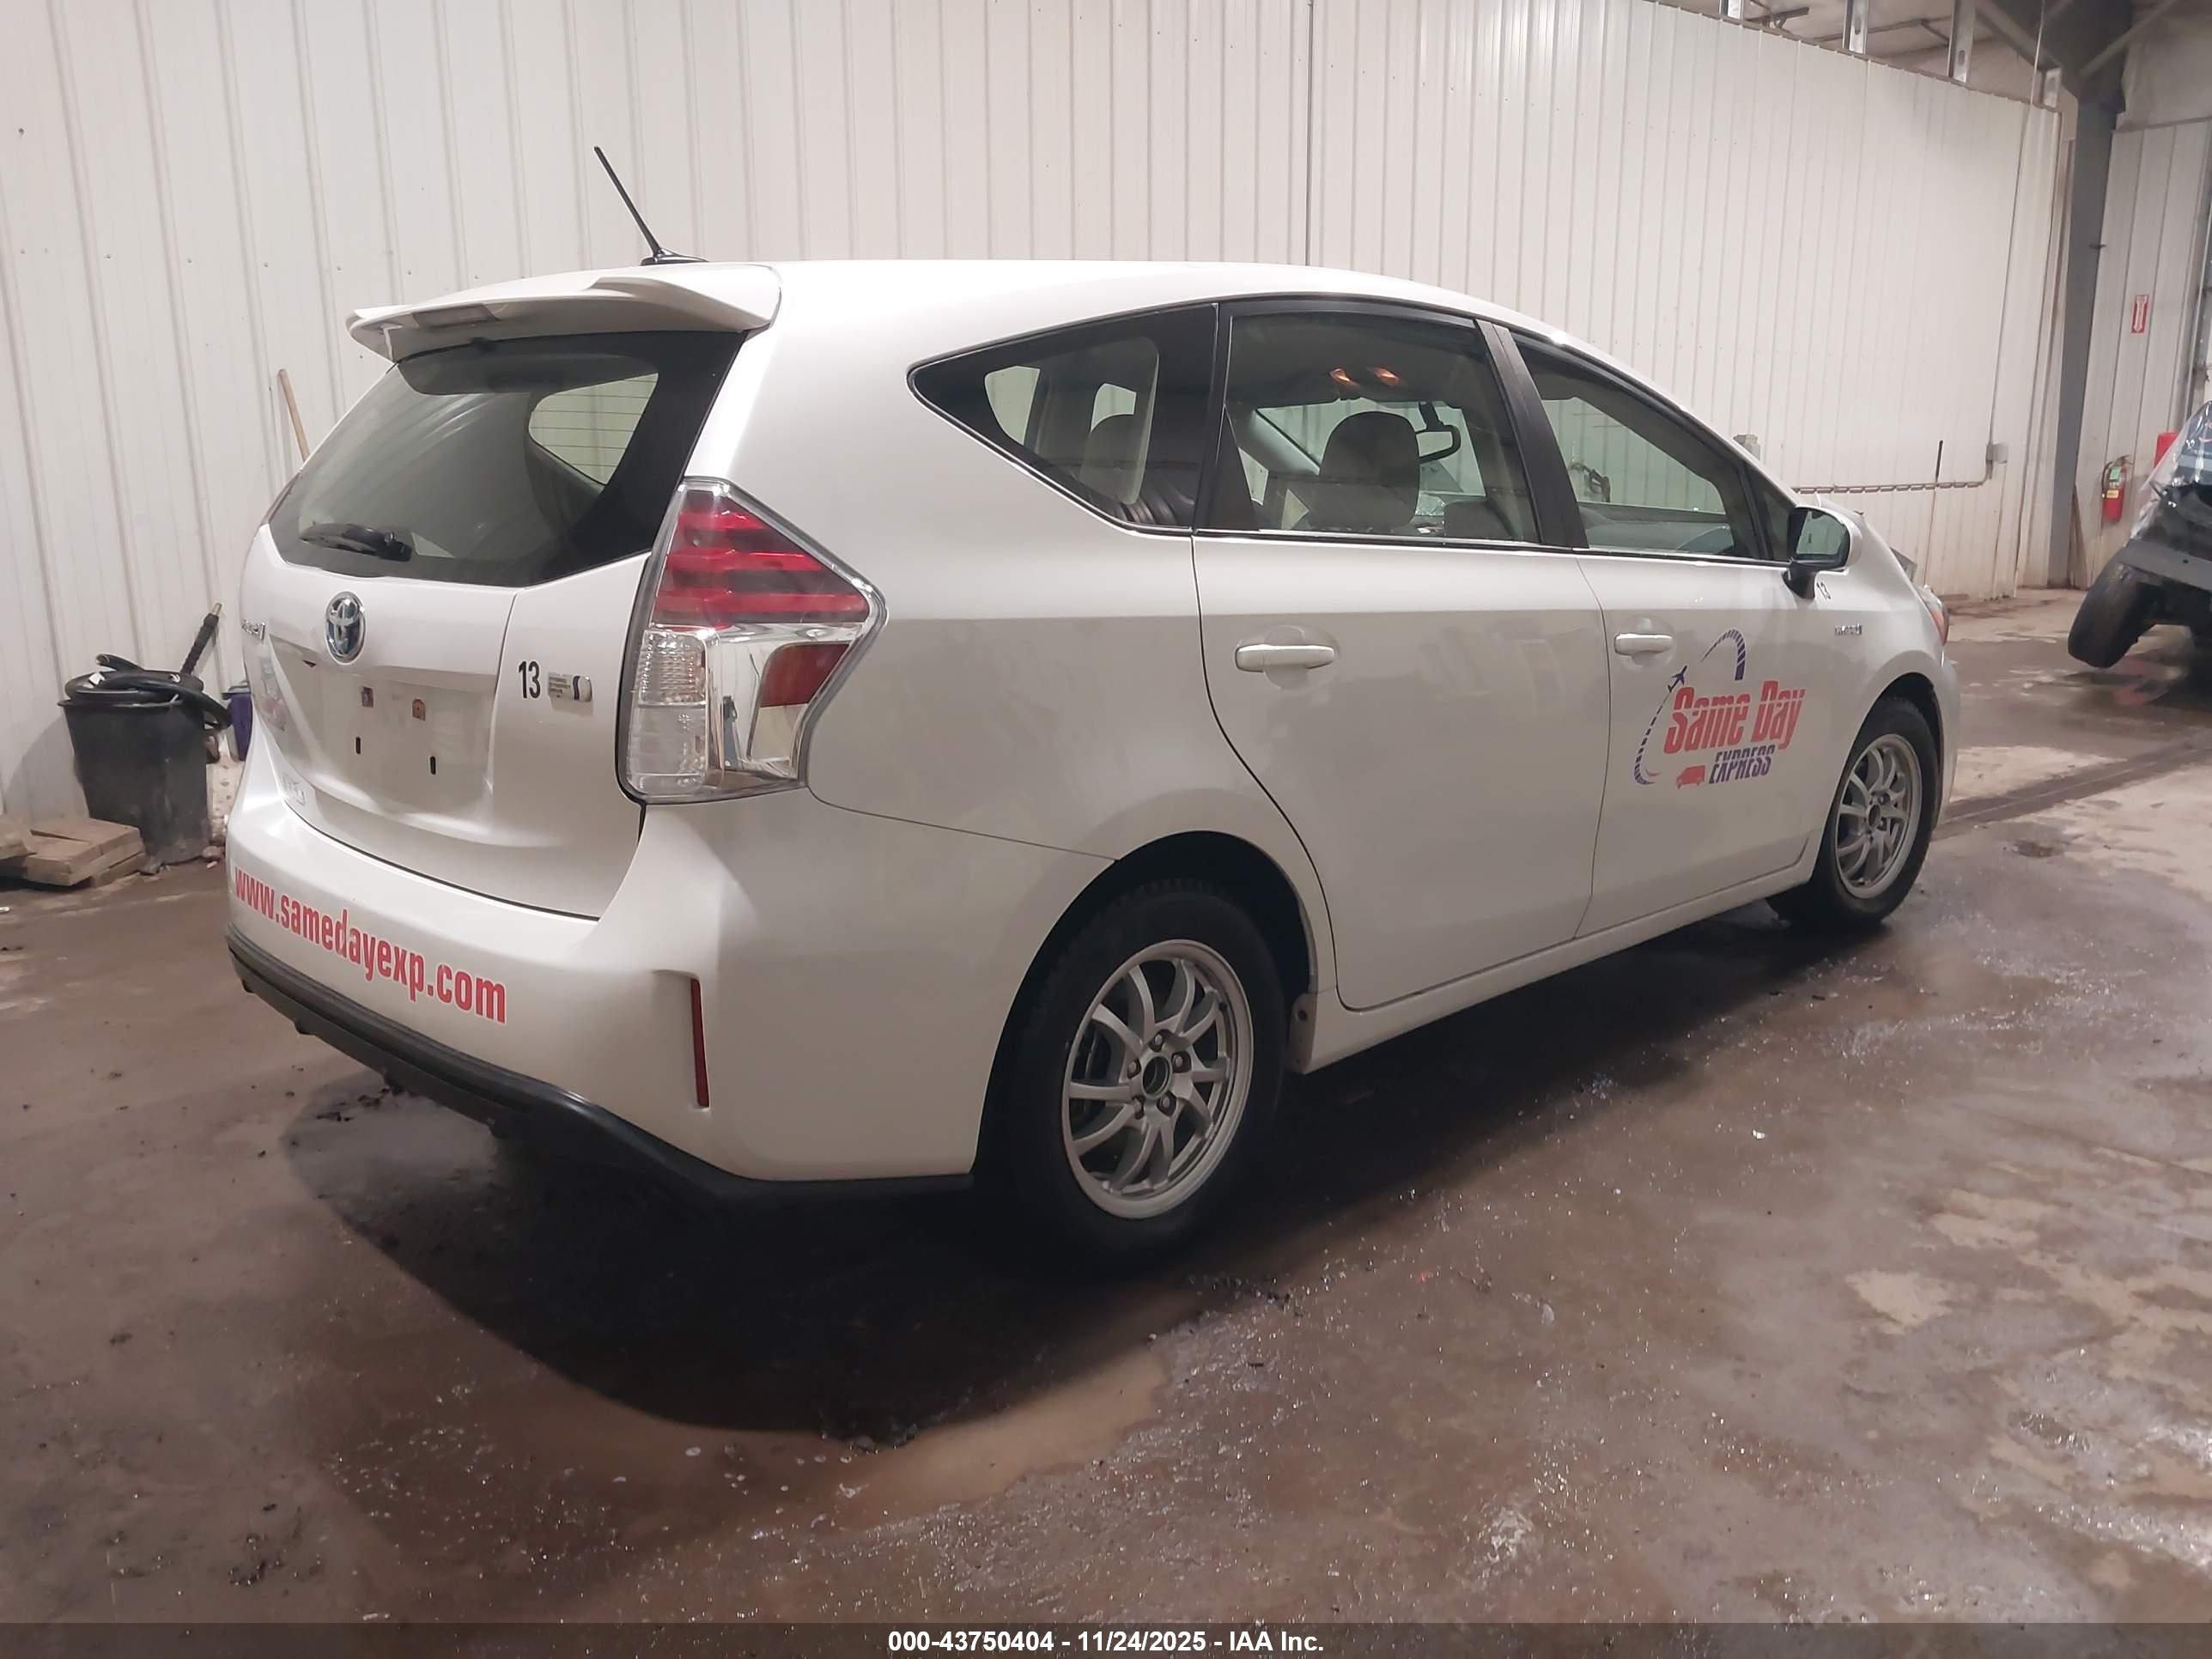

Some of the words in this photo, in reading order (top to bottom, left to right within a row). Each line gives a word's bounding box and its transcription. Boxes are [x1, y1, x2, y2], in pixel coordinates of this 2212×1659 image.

[518, 660, 541, 699] 13
[1663, 686, 1751, 754] Same
[1750, 680, 1805, 750] Day
[1708, 744, 1776, 784] EXPRESS
[234, 866, 507, 1024] www.samedayexp.com
